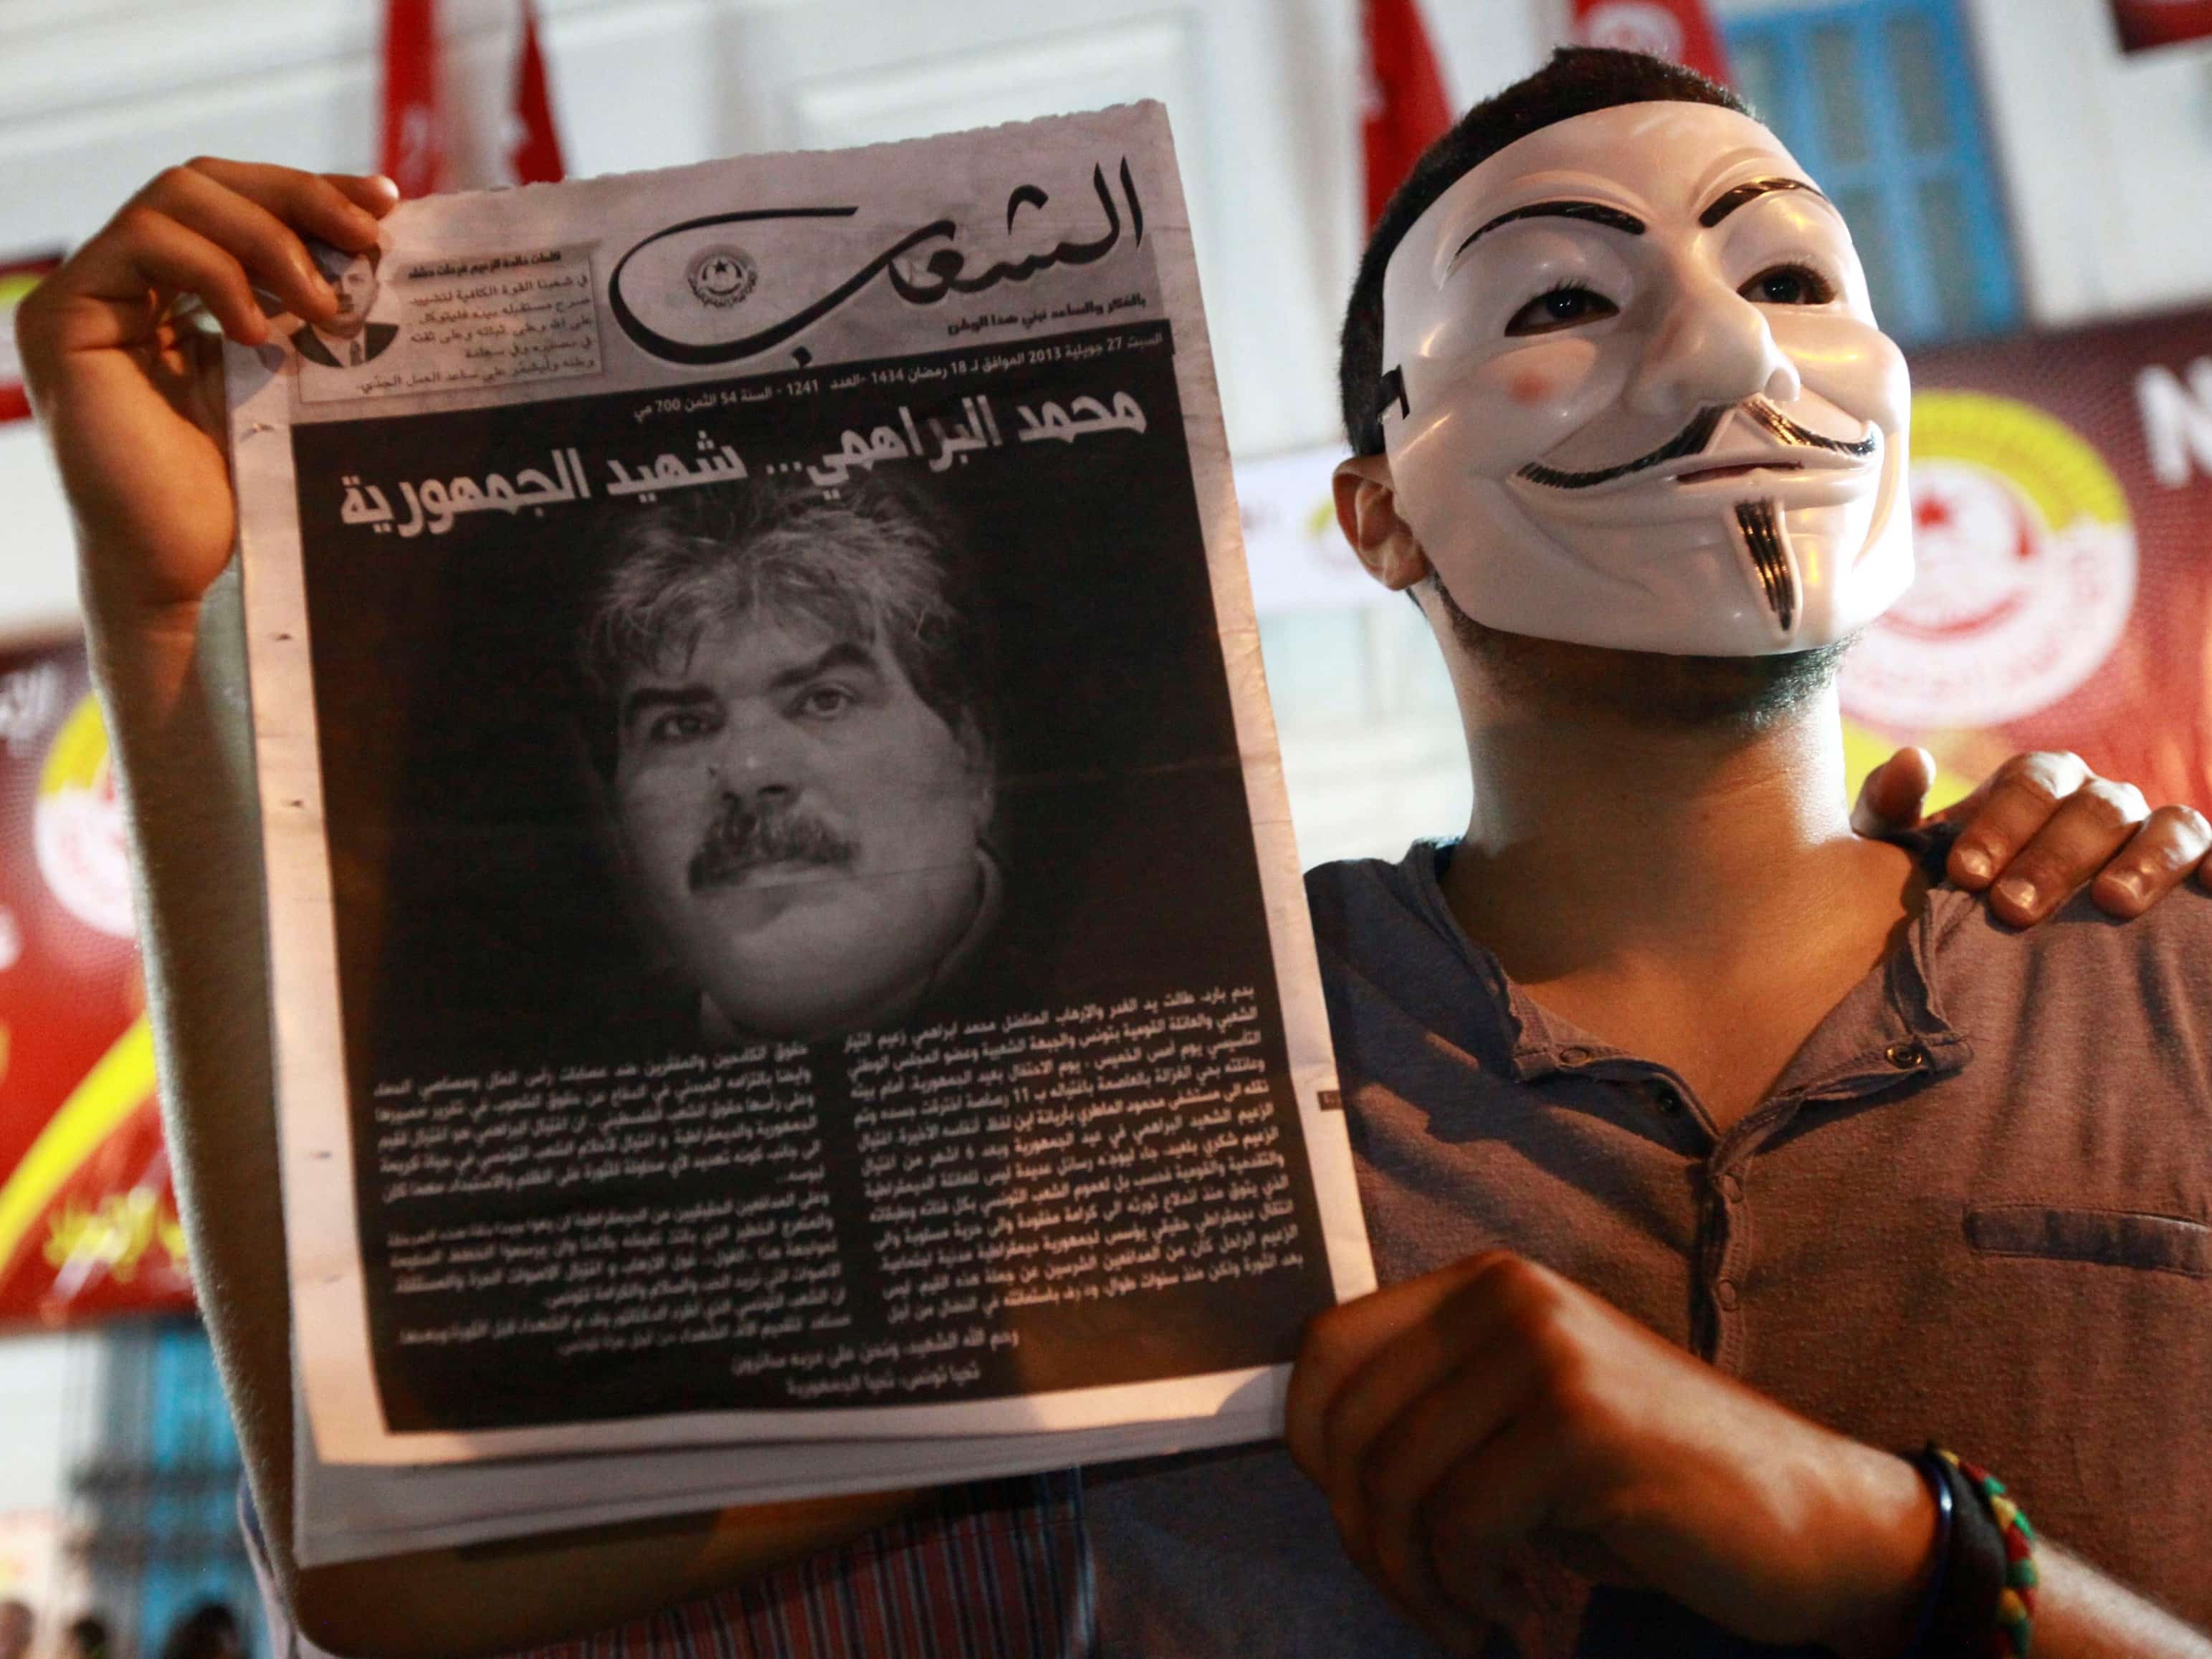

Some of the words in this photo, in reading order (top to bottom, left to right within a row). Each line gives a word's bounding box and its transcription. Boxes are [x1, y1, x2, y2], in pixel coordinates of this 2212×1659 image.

[606, 153, 1147, 368] الشعب
[1107, 335, 1122, 352] 27
[1127, 333, 1163, 349] السبت
[1028, 346, 1062, 364] 2013
[871, 368, 904, 384] 1434
[907, 366, 948, 383] رمضان
[950, 360, 967, 375] 18
[741, 386, 773, 402] السنة
[786, 378, 818, 396] 1241
[655, 398, 681, 413] 700
[685, 393, 717, 411] الثمن
[720, 391, 738, 405] 54
[1015, 390, 1147, 444] محمد
[604, 429, 746, 502] شهيد
[340, 446, 591, 539] الجمهورية
